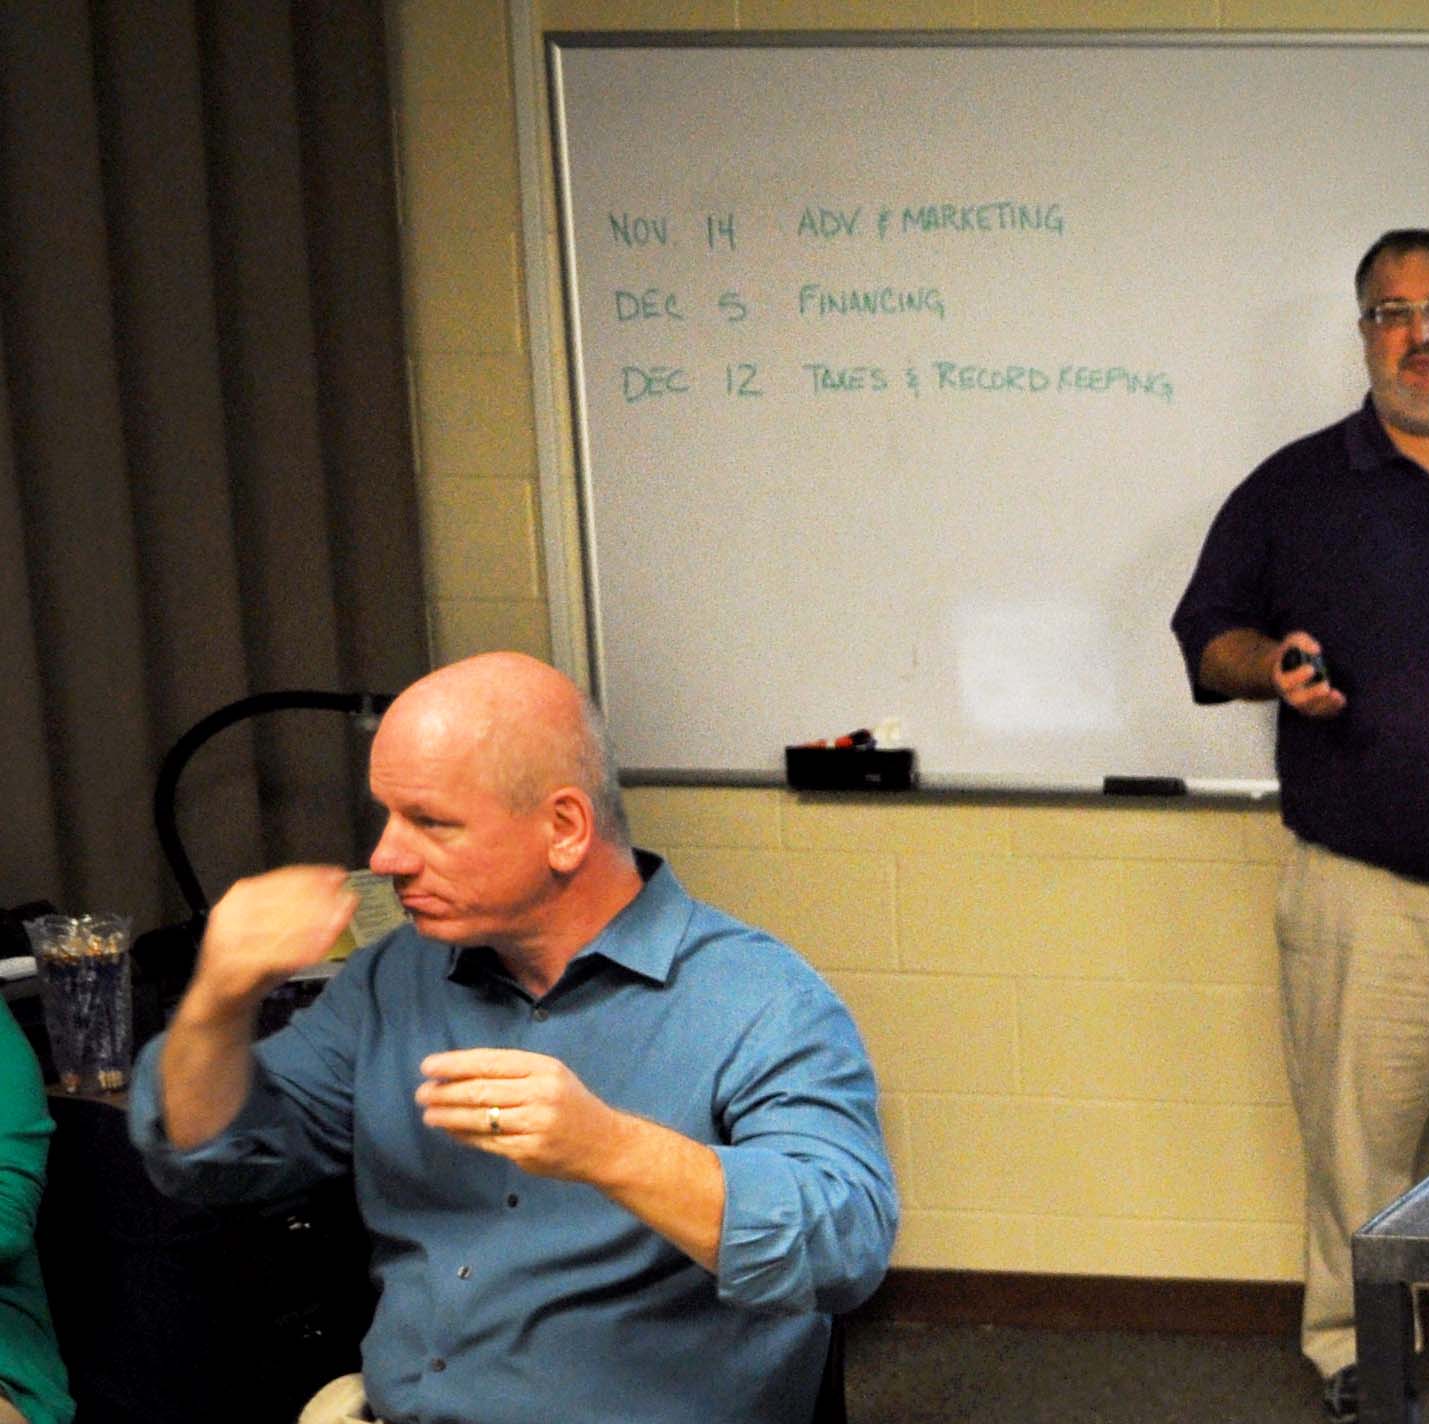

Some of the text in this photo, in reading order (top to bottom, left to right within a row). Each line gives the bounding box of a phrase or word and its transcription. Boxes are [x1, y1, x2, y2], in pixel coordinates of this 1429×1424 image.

[706, 212, 736, 250] 14
[902, 201, 1066, 237] MARKETING
[615, 283, 945, 323] DEC 5 FINANCING
[622, 365, 690, 404] DEC
[726, 363, 766, 398] 12
